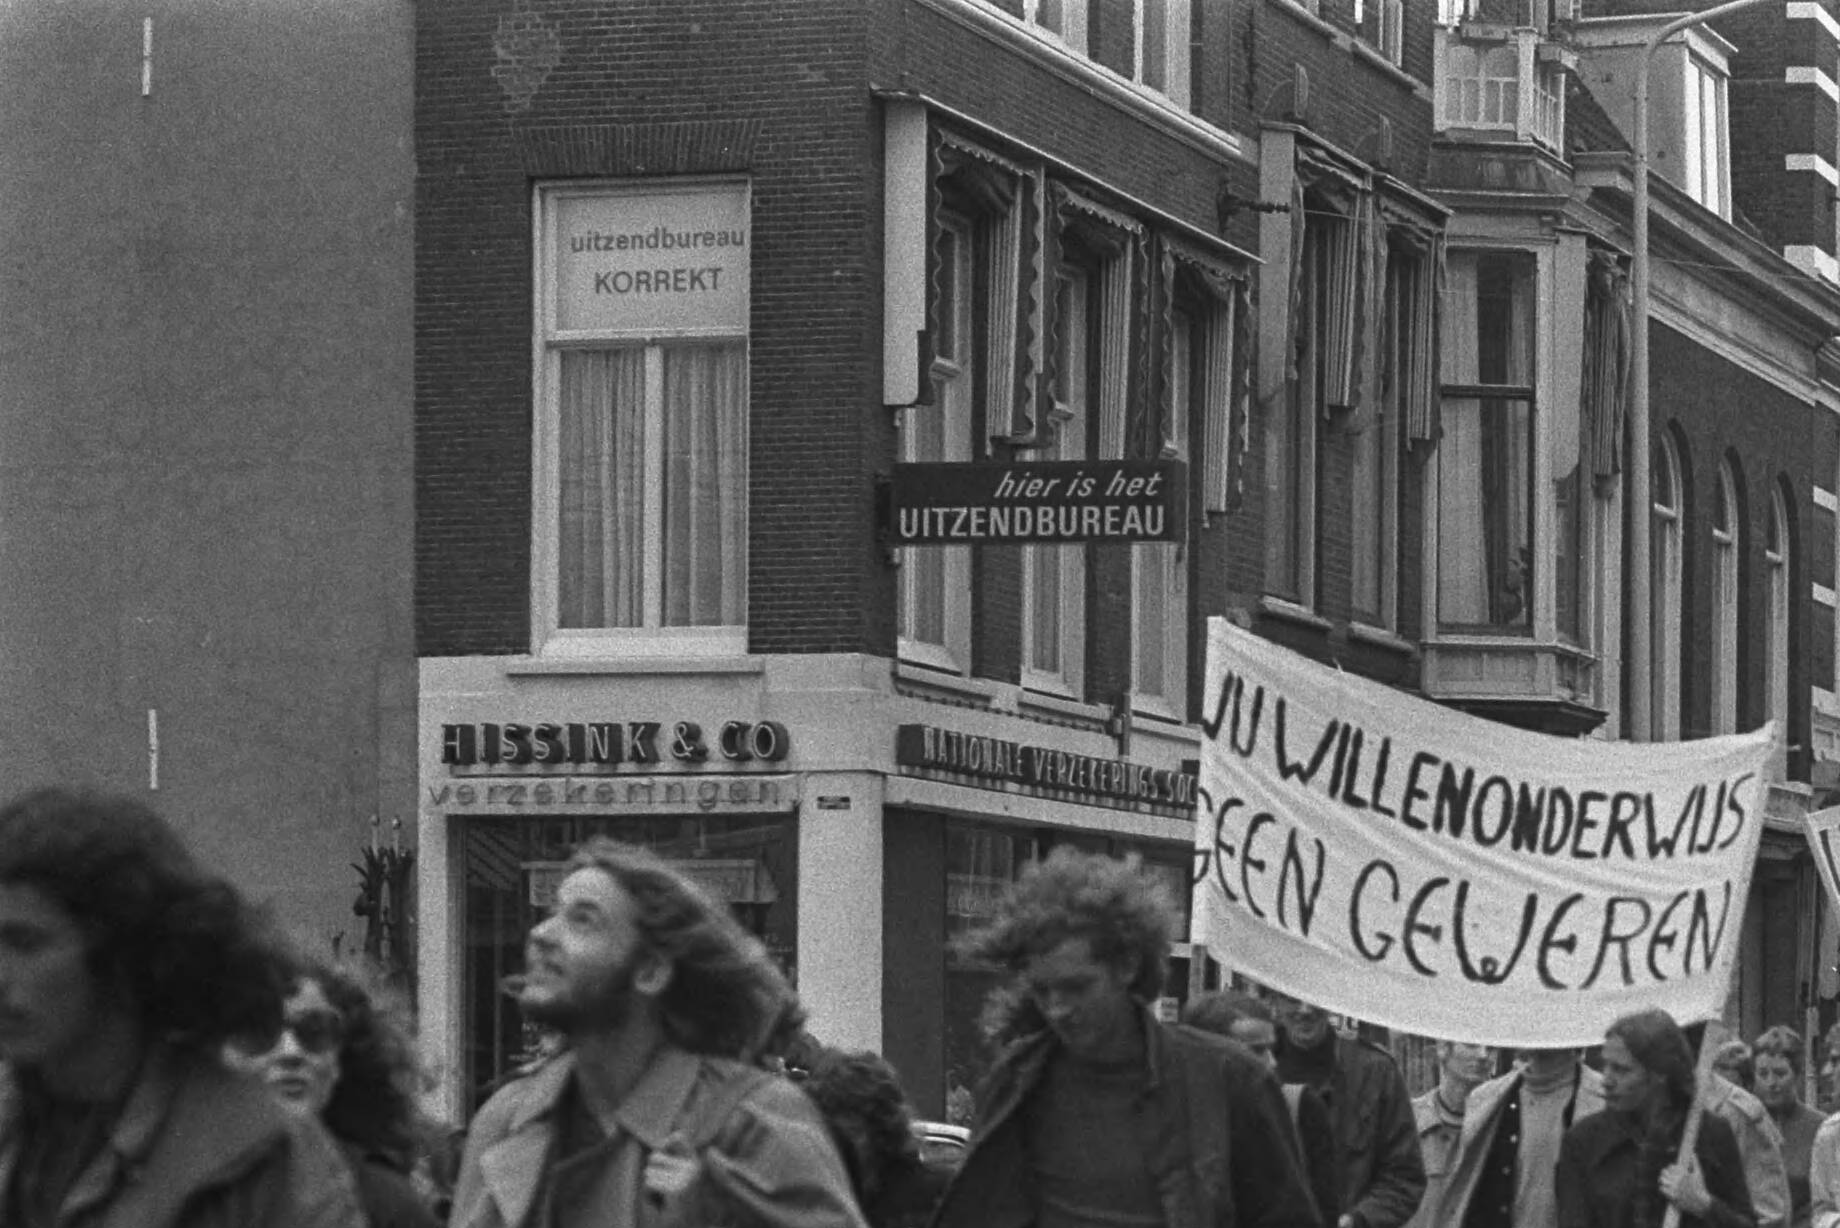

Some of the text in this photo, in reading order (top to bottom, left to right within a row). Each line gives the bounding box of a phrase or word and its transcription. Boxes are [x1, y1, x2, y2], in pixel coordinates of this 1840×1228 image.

[570, 227, 745, 252] uitzendbureau
[595, 267, 722, 294] KORREKT
[994, 469, 1162, 498] hier is het
[900, 505, 1165, 538] UITZENDBUREAU
[441, 720, 791, 765] HISSINK & CO
[921, 727, 1025, 778] NATIONALE
[1349, 858, 1733, 991] GEWEREN
